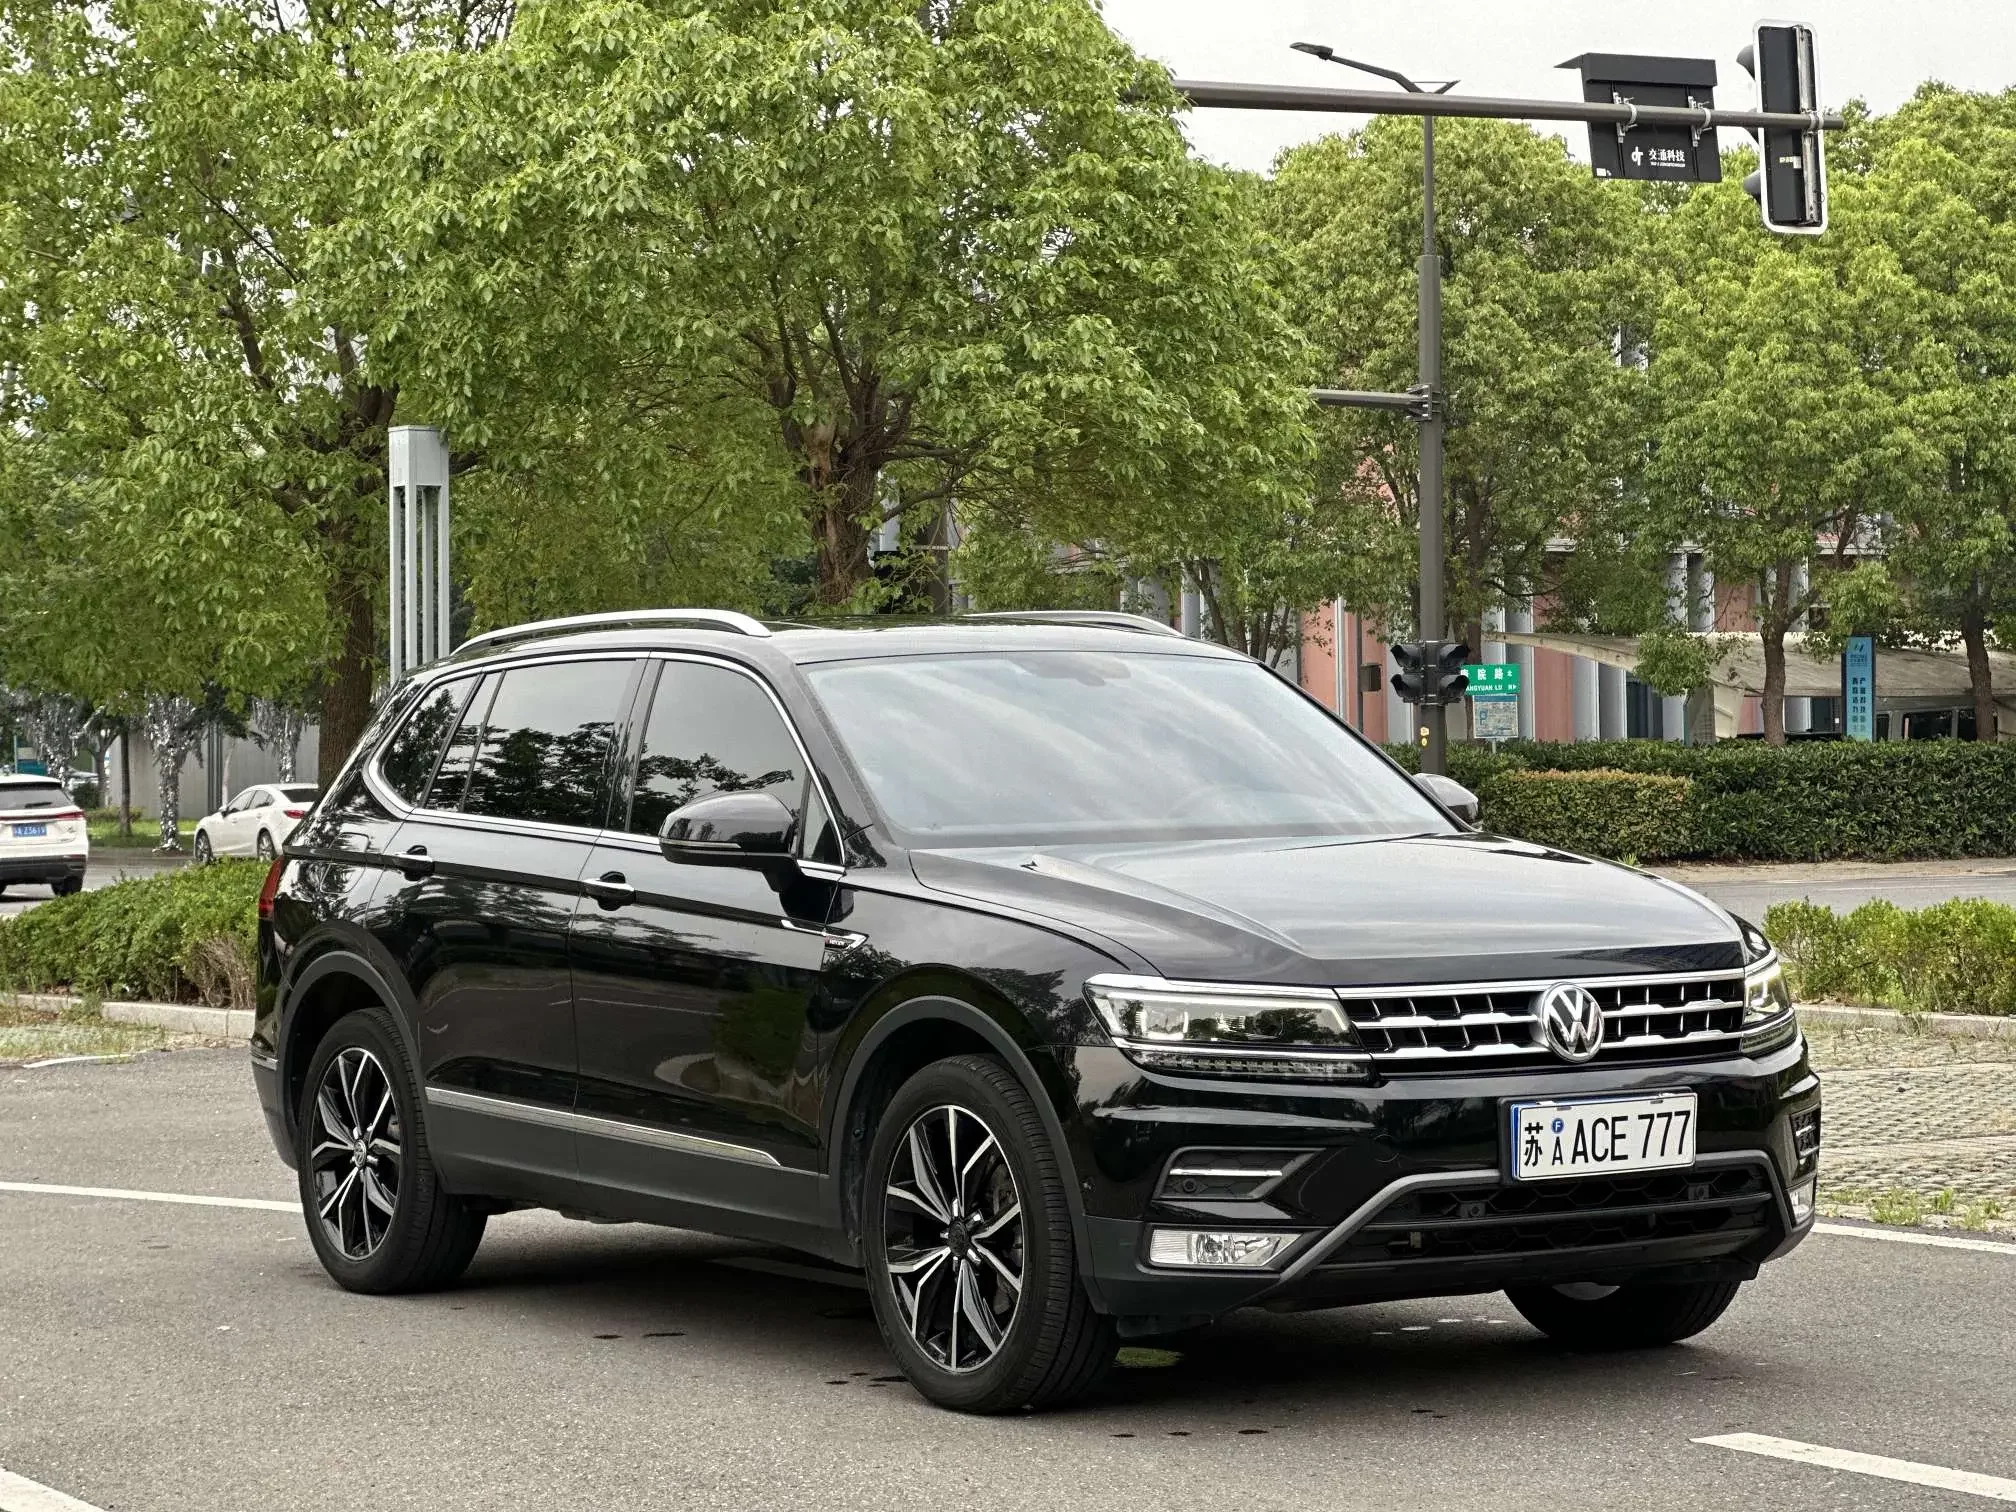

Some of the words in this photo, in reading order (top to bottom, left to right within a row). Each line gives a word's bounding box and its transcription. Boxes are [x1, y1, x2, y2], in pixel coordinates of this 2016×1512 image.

[1649, 149, 1686, 162] 交通科技
[1524, 1121, 1544, 1167] 苏
[1551, 1136, 1564, 1166] A
[1571, 1115, 1629, 1165] ACE
[1637, 1110, 1691, 1159] 777
